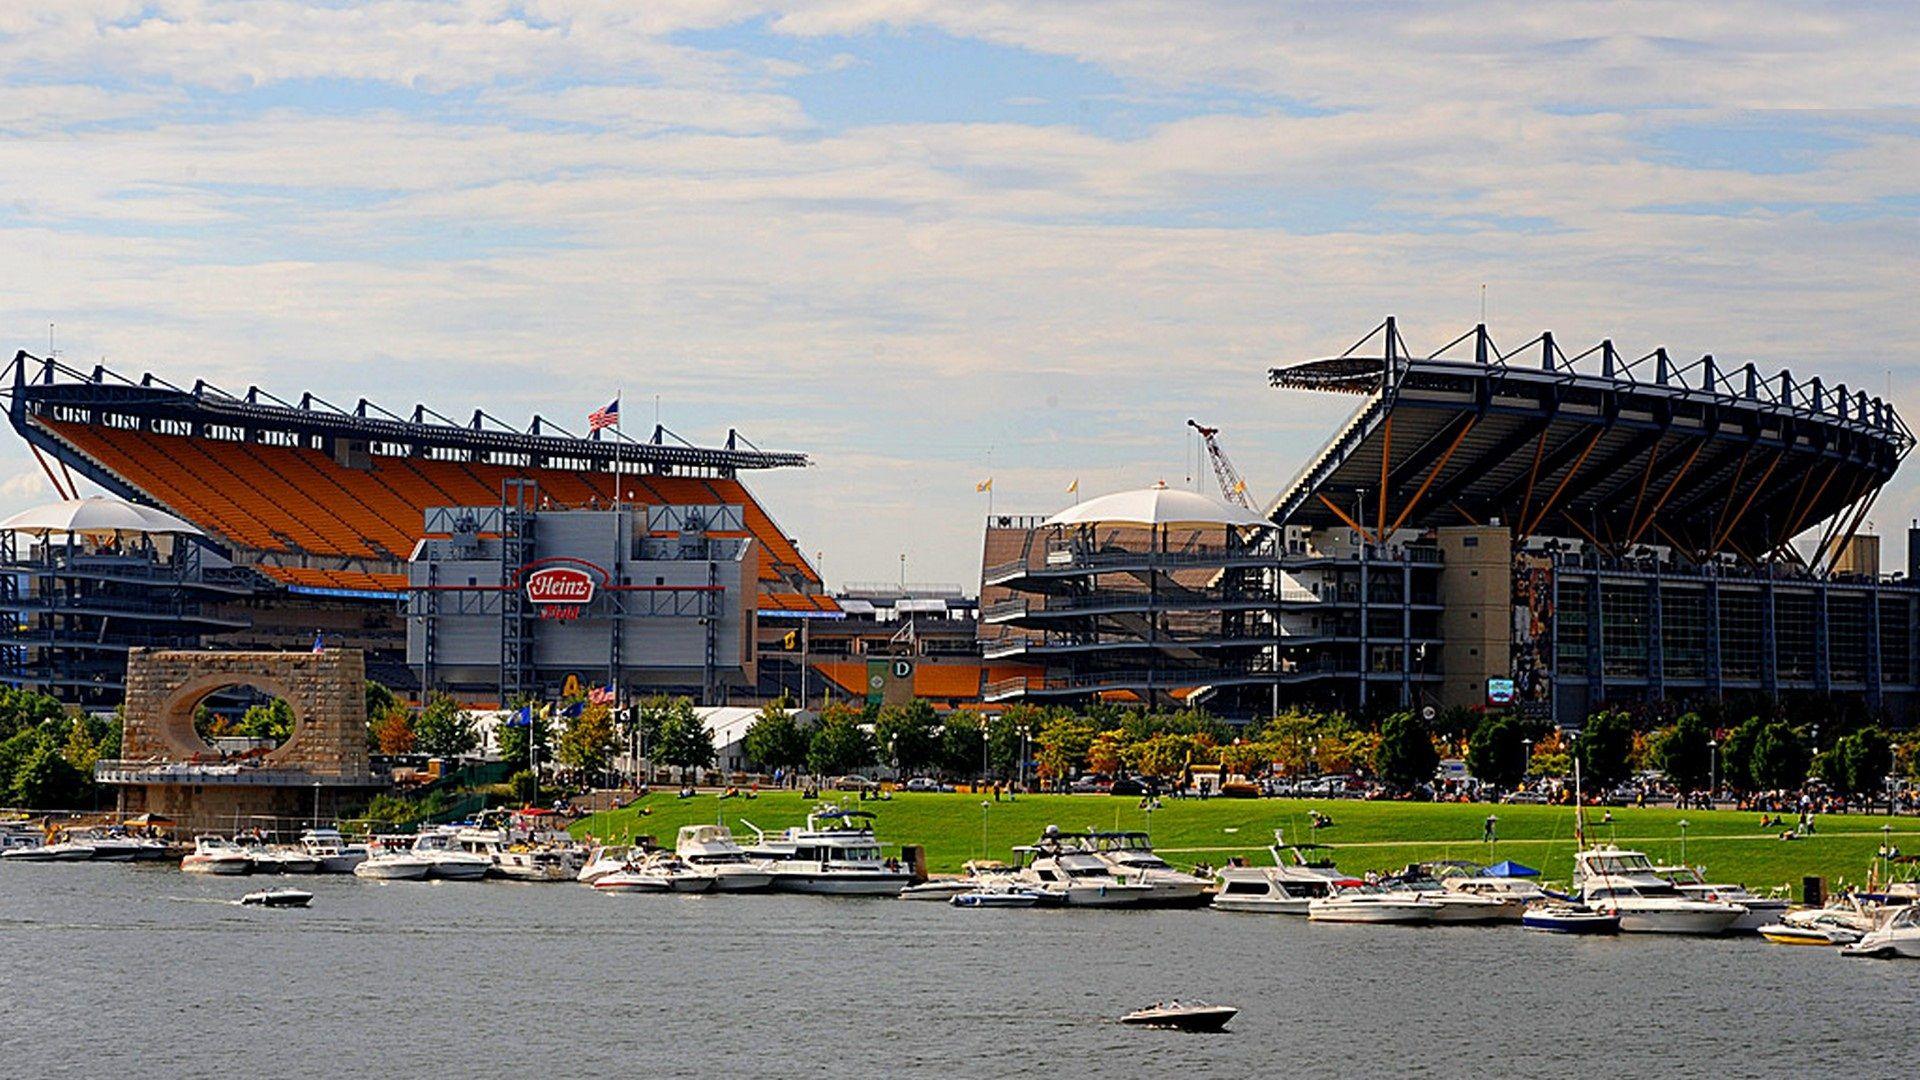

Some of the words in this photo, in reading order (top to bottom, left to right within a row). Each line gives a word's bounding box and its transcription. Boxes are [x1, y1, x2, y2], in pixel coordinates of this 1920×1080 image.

[533, 576, 587, 595] Heinz
[896, 661, 910, 676] D
[562, 674, 581, 697] A
